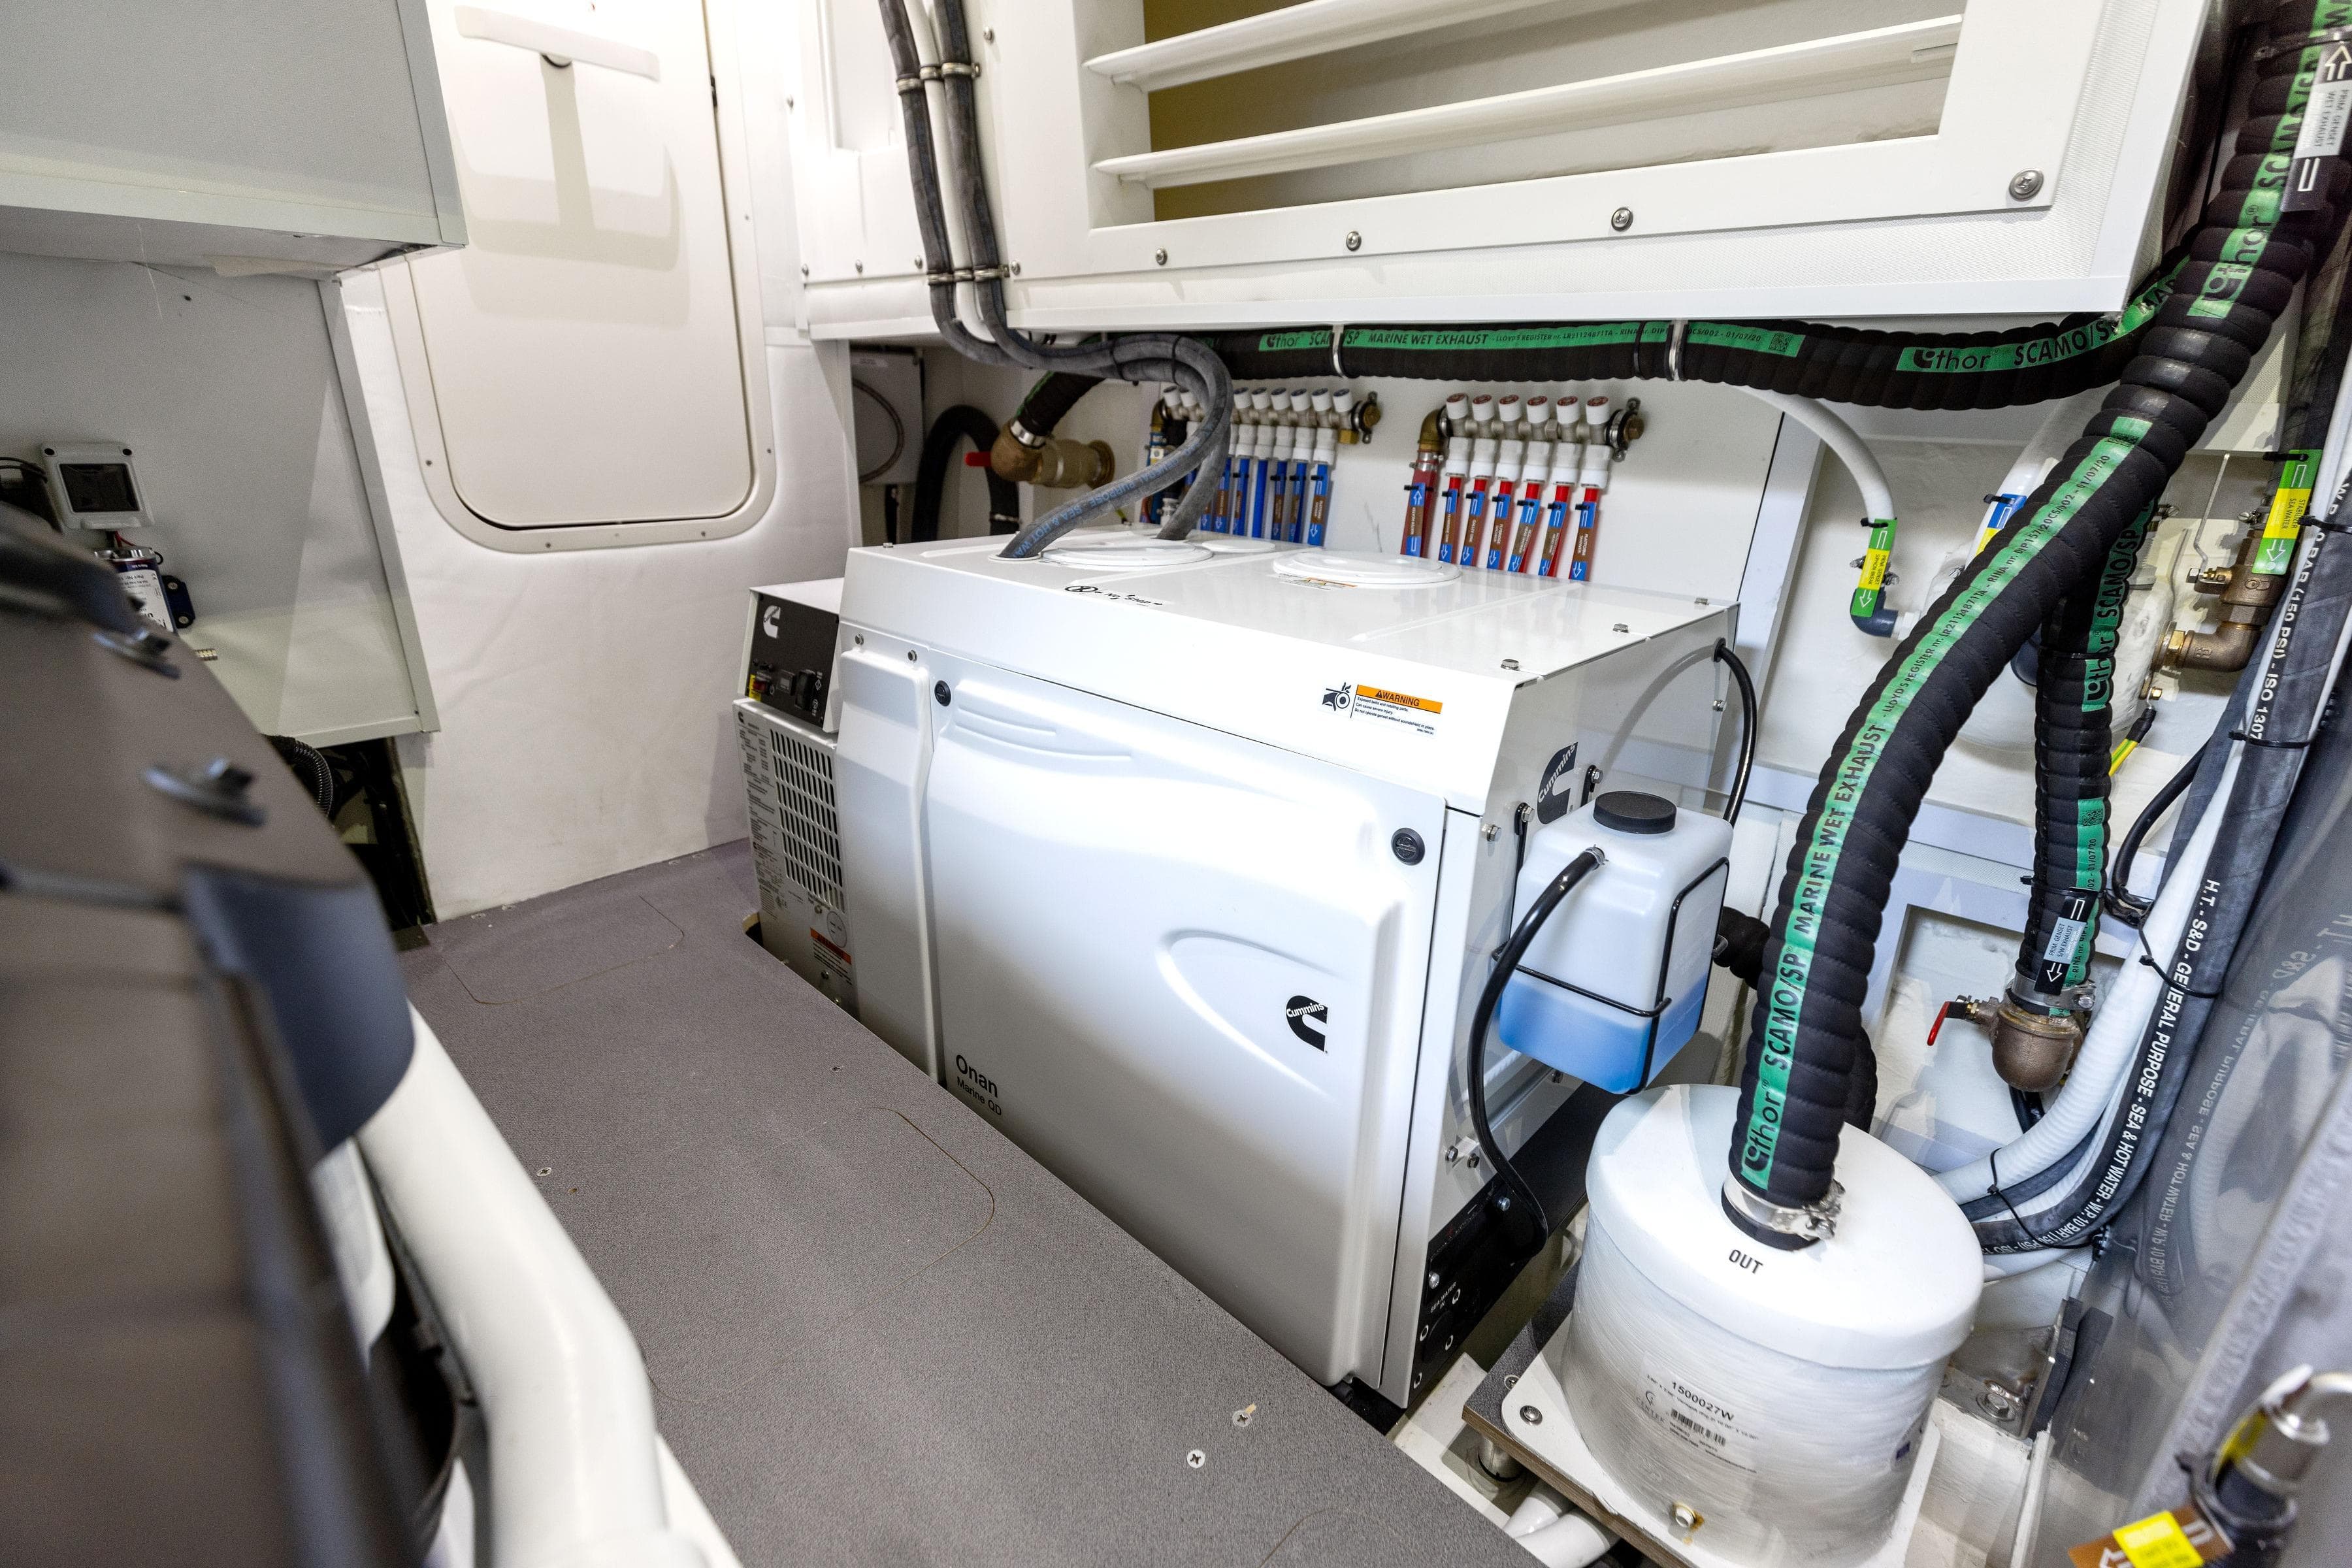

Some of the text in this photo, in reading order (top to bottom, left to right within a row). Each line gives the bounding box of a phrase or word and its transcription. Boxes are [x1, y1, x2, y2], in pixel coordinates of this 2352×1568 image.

[1368, 333, 1408, 344] MARINE
[1411, 334, 1433, 345] WET
[1435, 333, 1488, 345] EXHAUST
[1725, 329, 1761, 342] 01/07/20
[1088, 481, 1135, 507] PURPOSE
[1060, 504, 1083, 521] SEA
[2281, 498, 2296, 530] SEA WATER
[1031, 523, 1052, 542] HOT
[1013, 540, 1032, 557] WA
[1871, 554, 1880, 570] SIPHON
[2299, 545, 2322, 583] BAR
[2272, 626, 2291, 660] PSI)
[1382, 691, 1420, 707] WARNING
[2259, 672, 2280, 702] ISO
[1401, 719, 1420, 727] soundshield
[1538, 743, 1576, 804] Cummins
[1764, 953, 1807, 1071] SCAMO/SP
[1793, 851, 1831, 934] MARINE
[1818, 807, 1846, 847] WET
[1835, 725, 1886, 803] EXHAUST
[1884, 682, 1909, 713] LLOYD'S
[1906, 648, 1935, 683] REGISTER
[1932, 636, 1944, 648] nr.
[1987, 565, 2009, 583] RINA
[2006, 555, 2019, 566] nr.
[2076, 455, 2111, 489] 01/07/20
[2087, 839, 2096, 871] 01/07/20
[2055, 923, 2065, 941] GENSET
[2062, 926, 2073, 947] EXHAUST
[2186, 919, 2208, 953] S&D
[2072, 956, 2082, 973] RINA
[1286, 1002, 1325, 1019] Cummins
[955, 1054, 998, 1099] Onan
[2137, 1031, 2170, 1098] PURPOSE
[956, 1076, 1002, 1117] Marine QD
[2126, 1103, 2147, 1130] SEA
[2122, 1130, 2138, 1141] &
[2114, 1141, 2134, 1168] HOT
[2096, 1164, 2125, 1200] WATER
[2058, 1222, 2081, 1239] BAR
[2074, 1216, 2089, 1228] 10
[1728, 1249, 1763, 1275] OUT
[1994, 1245, 2015, 1254] ISO
[1672, 1382, 1735, 1421] 1500027W
